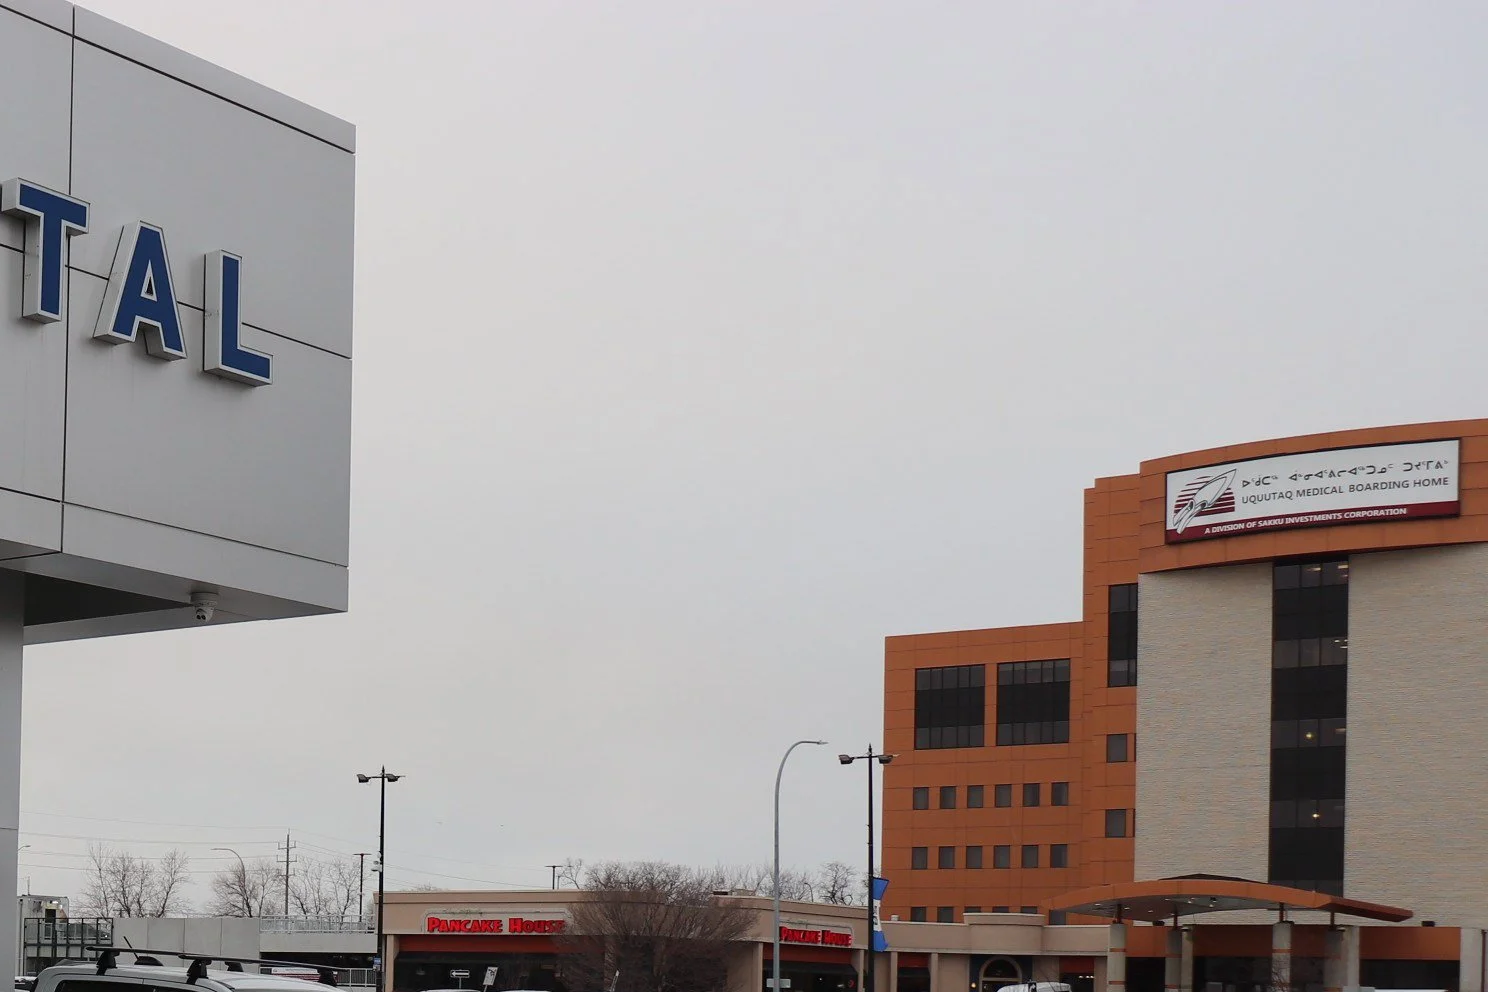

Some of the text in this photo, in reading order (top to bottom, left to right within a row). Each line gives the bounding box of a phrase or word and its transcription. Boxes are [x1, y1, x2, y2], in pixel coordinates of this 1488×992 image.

[1242, 477, 1449, 504] UQUUTAQ MEDICAL BOARDING HOME
[1204, 508, 1407, 535] A DIVISION OF SAKKU INVESTMENTS CORPORATION
[427, 917, 566, 933] PANCAKE HOUSE
[779, 926, 852, 947] PANCAKE HOUSE
